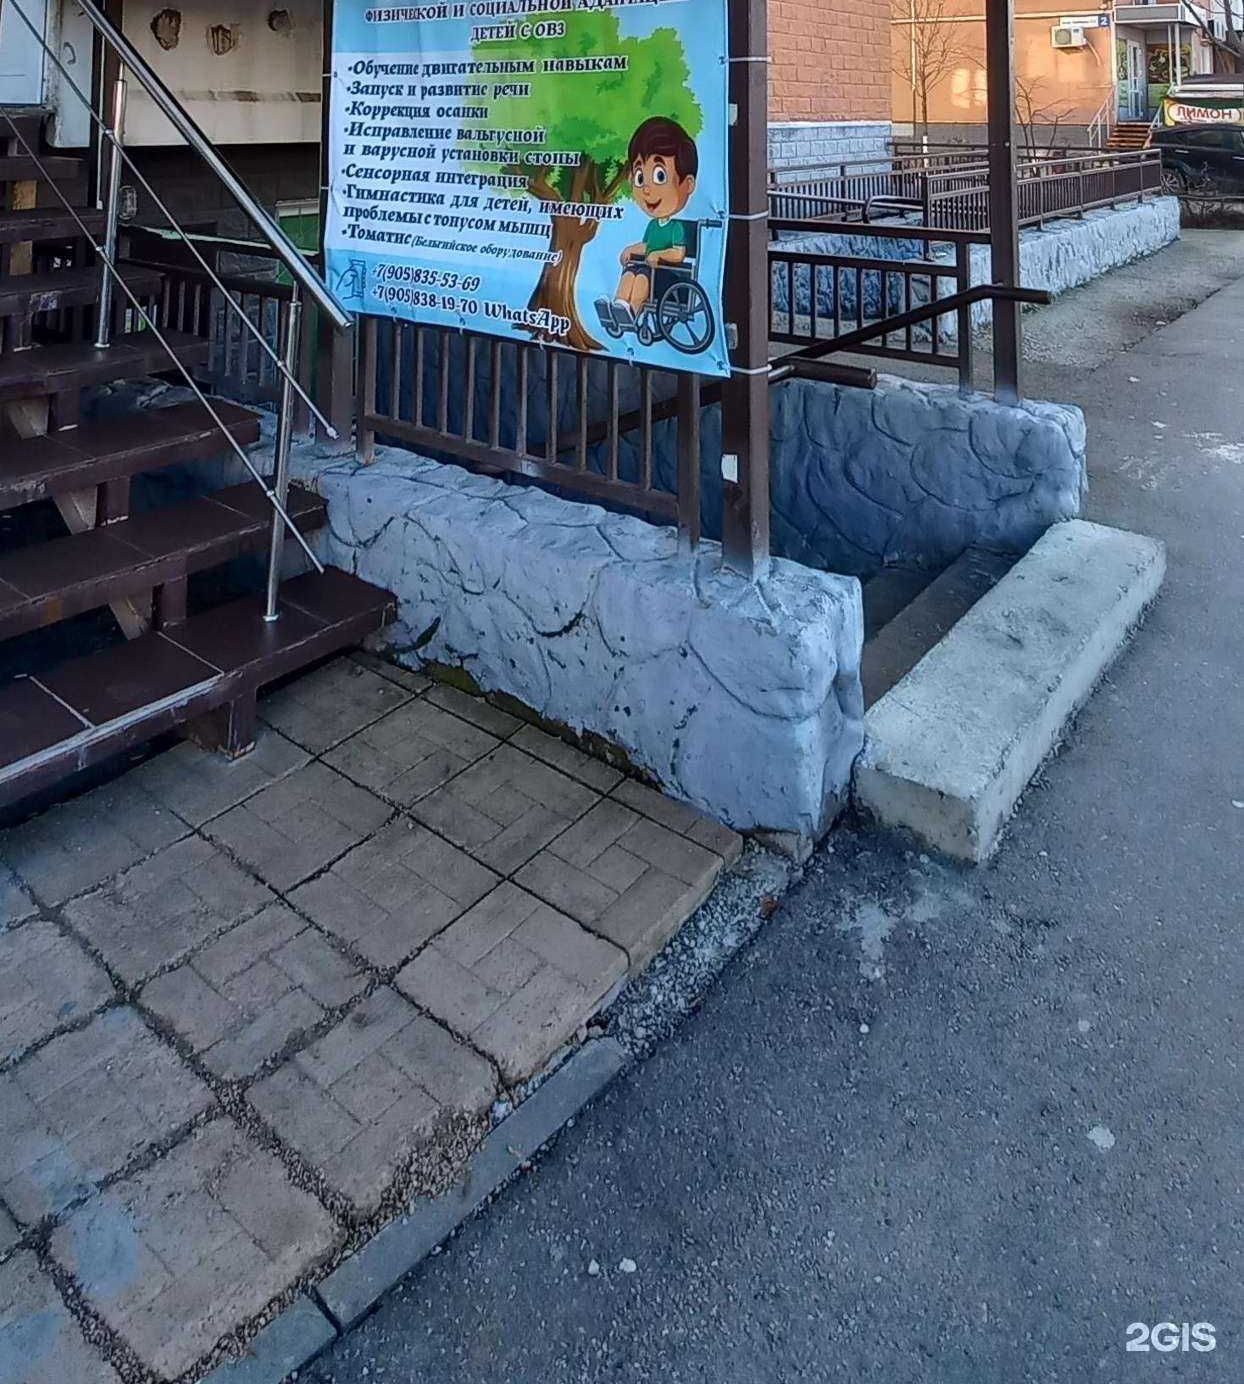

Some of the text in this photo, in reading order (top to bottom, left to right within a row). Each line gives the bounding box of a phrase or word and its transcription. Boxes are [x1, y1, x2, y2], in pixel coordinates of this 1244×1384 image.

[453, 4, 465, 17] И
[471, 21, 515, 42] ДЕТЕЙ
[353, 56, 627, 78] Обучение двигательным навыкам
[350, 81, 529, 100] Запуск и развитие речи
[350, 101, 488, 120] Коррекция осанки
[1178, 106, 1232, 119] ЛИМОН
[348, 122, 545, 144] Исправление вальгусной
[344, 144, 580, 166] и варусной установки стопы
[346, 164, 528, 190] Сенсорная интеграция
[347, 184, 625, 220] Гимнастика для детей, имеющих
[343, 205, 423, 224] проблемы
[500, 222, 551, 239] мышц
[348, 224, 412, 245] Томатис
[372, 285, 571, 335] +7(905)838-19-70 WhatsApp
